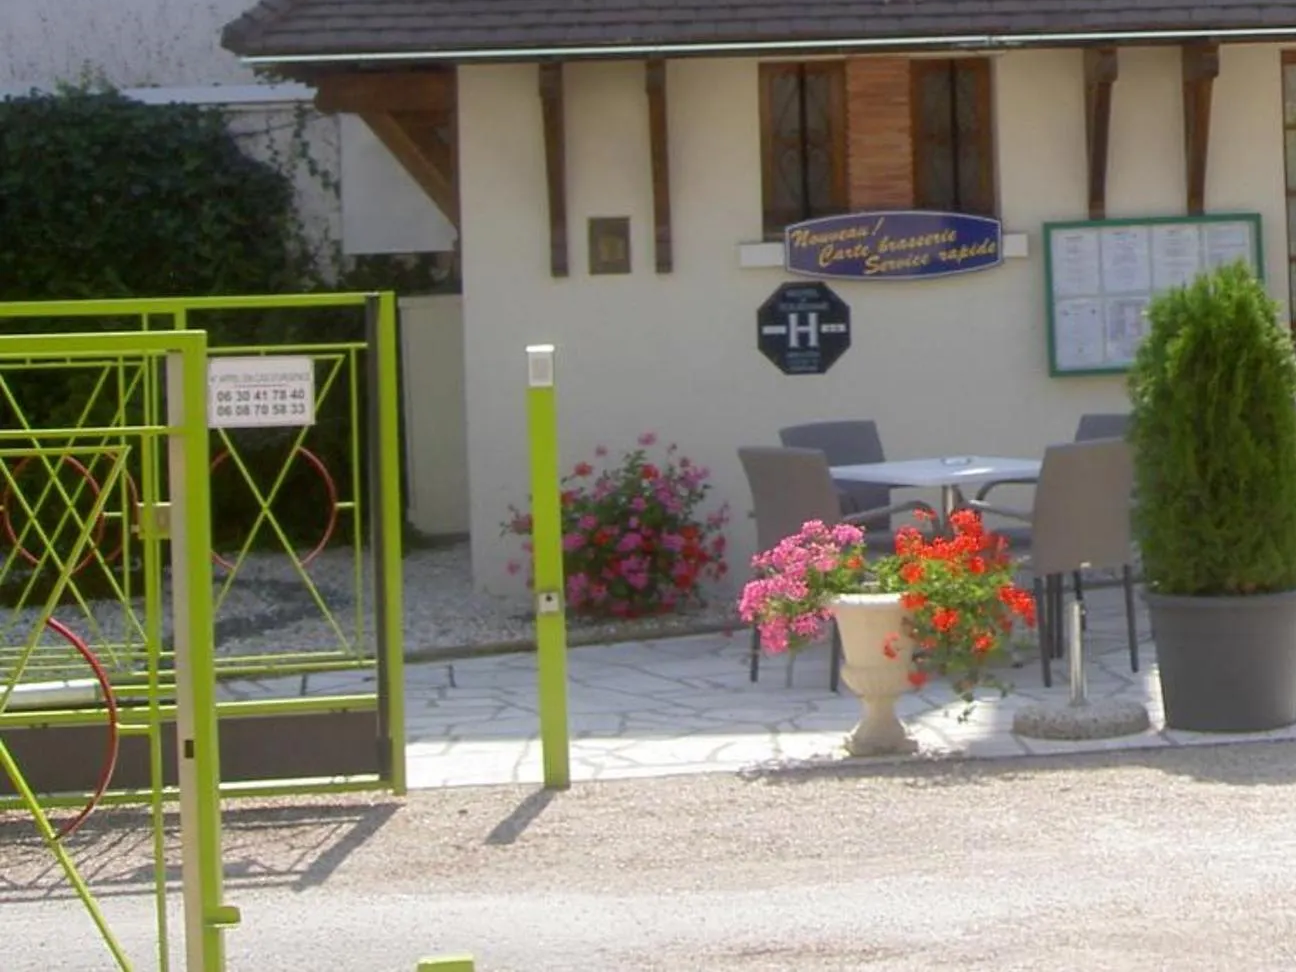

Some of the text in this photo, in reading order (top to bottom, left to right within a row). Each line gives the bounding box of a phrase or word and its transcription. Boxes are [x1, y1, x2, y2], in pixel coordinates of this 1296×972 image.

[818, 229, 957, 268] Carte brasserie
[863, 238, 997, 275] Service rapide
[788, 312, 820, 348] H
[217, 390, 233, 402] 06
